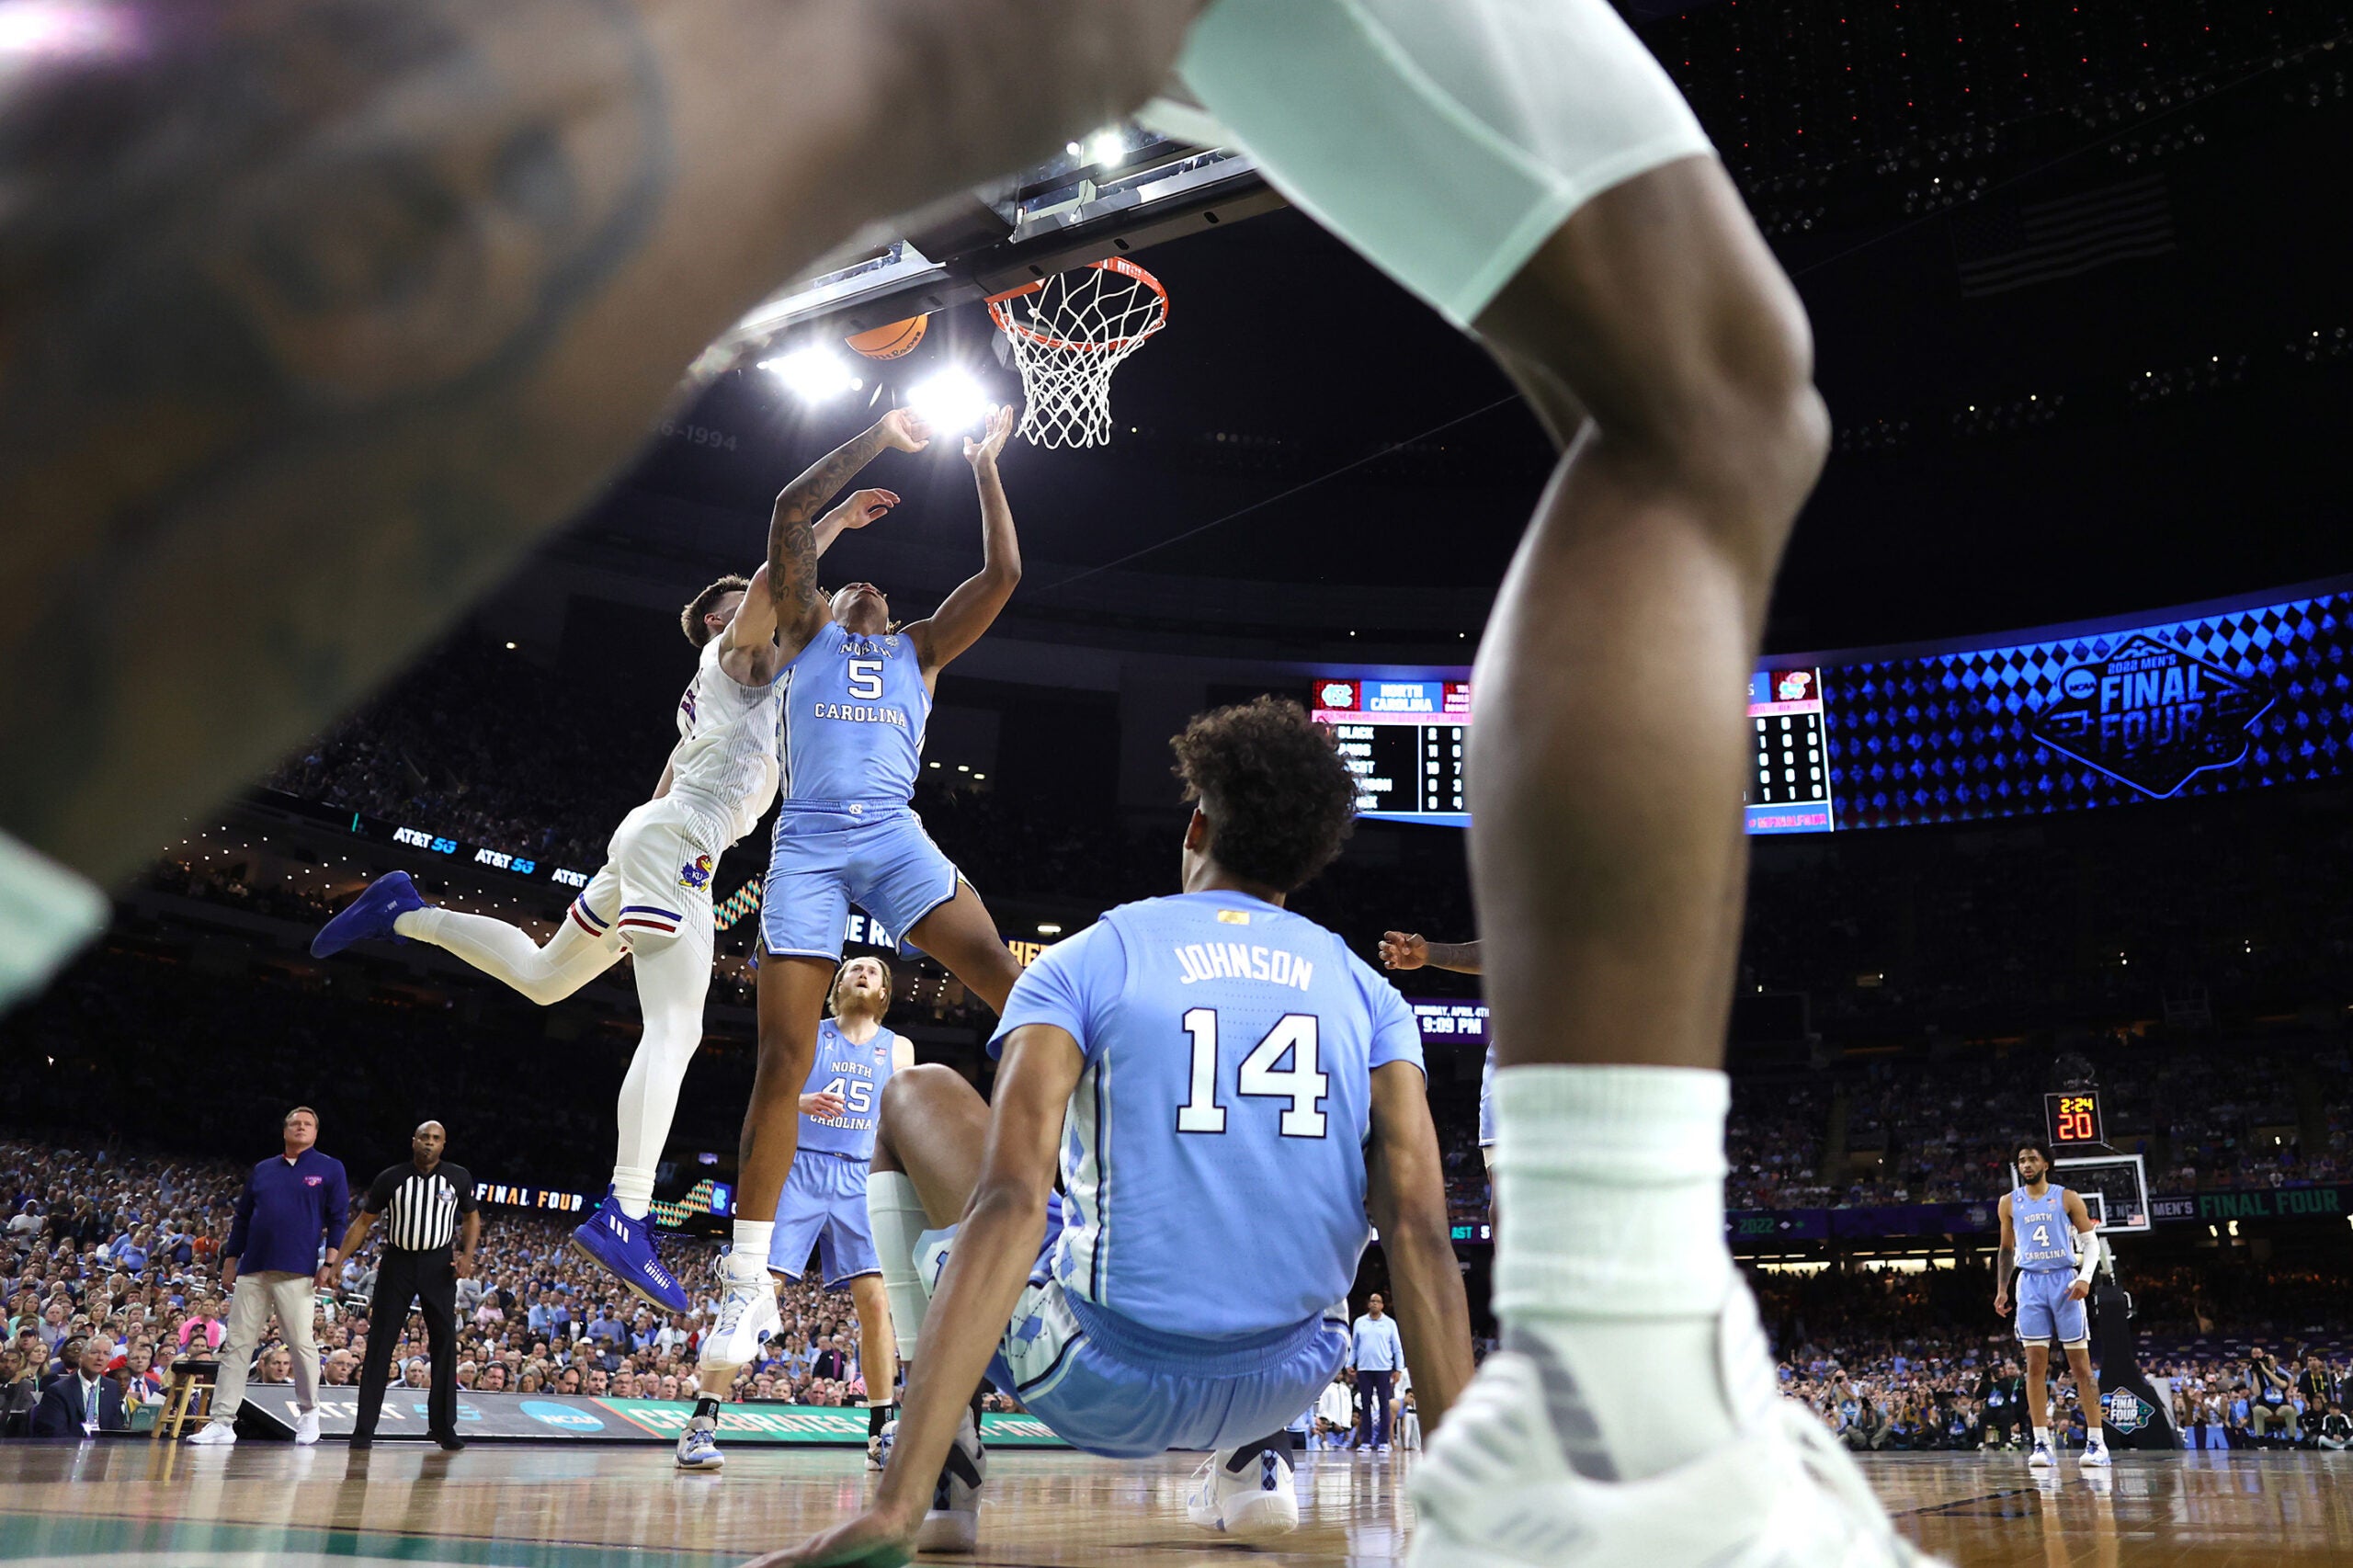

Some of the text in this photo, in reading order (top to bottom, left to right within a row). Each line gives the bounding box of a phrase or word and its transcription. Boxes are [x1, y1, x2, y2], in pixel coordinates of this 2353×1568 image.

[839, 641, 893, 659] NORTH
[847, 658, 884, 700] 5
[2100, 664, 2206, 713] FINAL
[1381, 684, 1424, 698] NORTH
[1370, 698, 1434, 712] CAROLINA
[814, 702, 907, 728] CAROLINA
[1337, 725, 1375, 740] BLACK
[2100, 703, 2203, 754] FOUR
[1453, 761, 1462, 775] 7
[392, 826, 458, 855] AT&T 5G
[474, 847, 536, 874] AT&T 5G
[551, 868, 587, 888] AT&T
[1174, 942, 1313, 992] JOHNSON
[1422, 1017, 1482, 1035] 9:09 PM
[830, 1062, 873, 1078] NORTH
[1176, 1006, 1329, 1140] 14
[822, 1076, 875, 1114] 45
[2060, 1097, 2094, 1114] 2:24
[2059, 1113, 2093, 1140] 20
[475, 1182, 529, 1200] FINAL
[537, 1190, 584, 1212] FOUR
[2153, 1199, 2194, 1216] MEN'S
[2199, 1194, 2270, 1218] FINAL
[2275, 1188, 2340, 1214] FOUR
[1739, 1218, 1774, 1234] 2022
[2024, 1212, 2052, 1223] NORTH
[2032, 1224, 2051, 1247] 4
[2024, 1248, 2066, 1261] CAROLINA
[2110, 1397, 2139, 1409] FINAL
[539, 1414, 600, 1426] NCAA
[2110, 1409, 2139, 1421] FOUR
